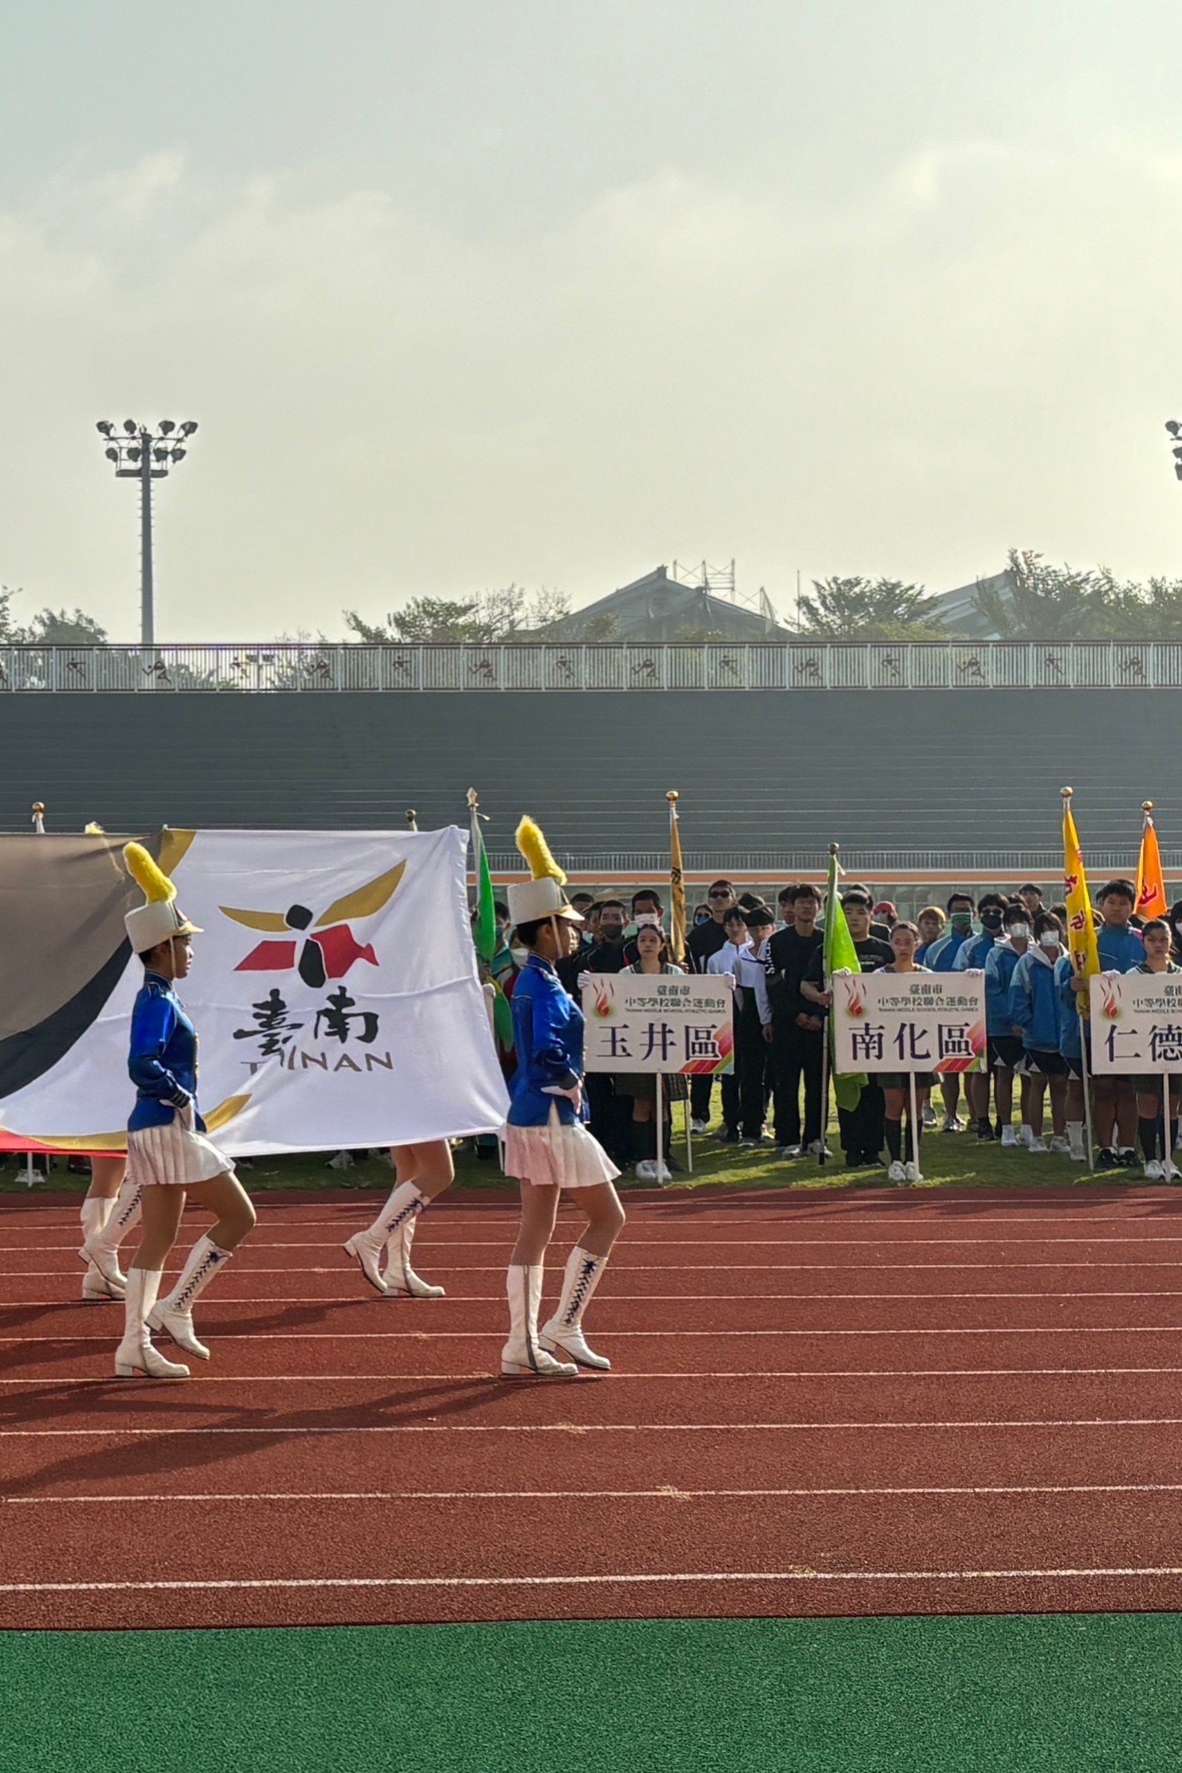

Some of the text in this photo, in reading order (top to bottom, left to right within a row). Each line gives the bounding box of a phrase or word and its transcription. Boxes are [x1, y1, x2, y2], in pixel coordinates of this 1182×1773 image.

[233, 985, 379, 1056] 臺南
[596, 1023, 720, 1061] 玉井區
[848, 1022, 973, 1060] 南化區
[1104, 1024, 1182, 1062] 仁德
